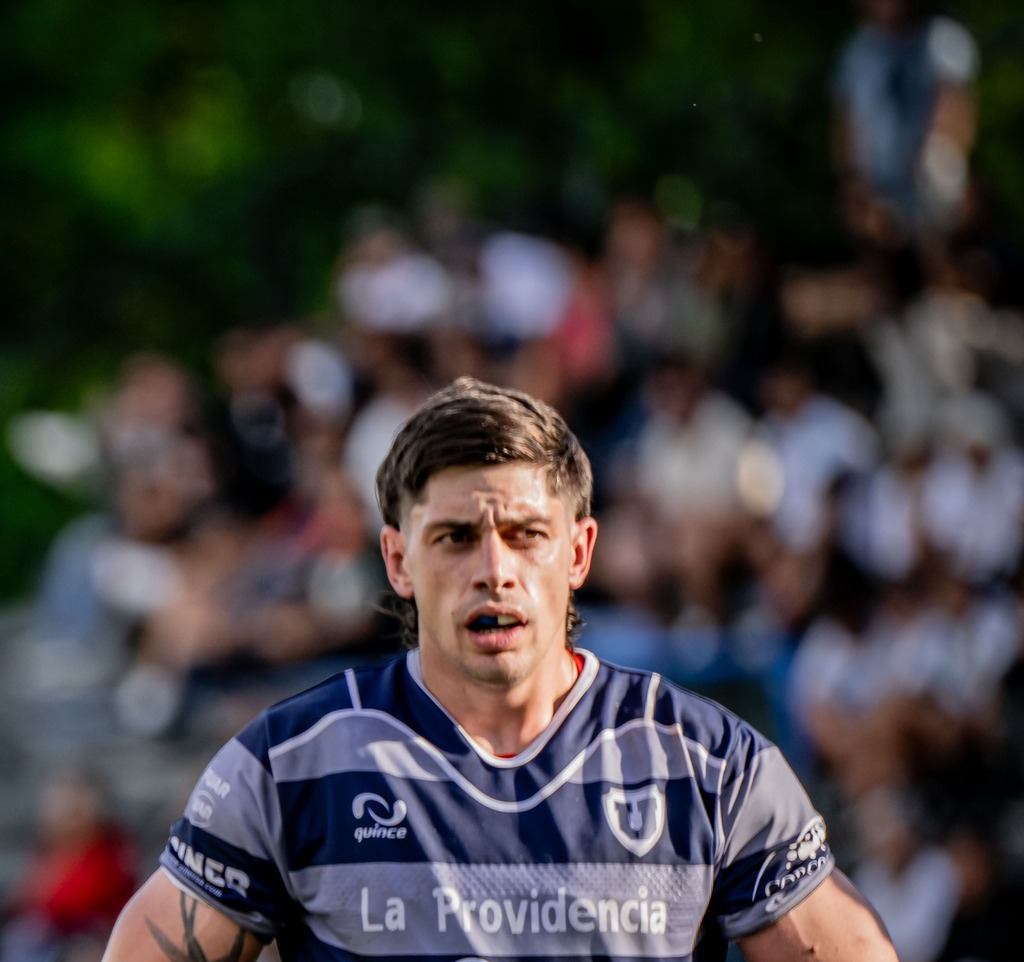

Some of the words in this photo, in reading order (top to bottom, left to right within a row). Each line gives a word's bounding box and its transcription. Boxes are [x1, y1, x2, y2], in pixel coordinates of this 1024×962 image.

[354, 823, 407, 843] quince
[361, 887, 405, 932] La
[433, 885, 667, 934] Providencia
